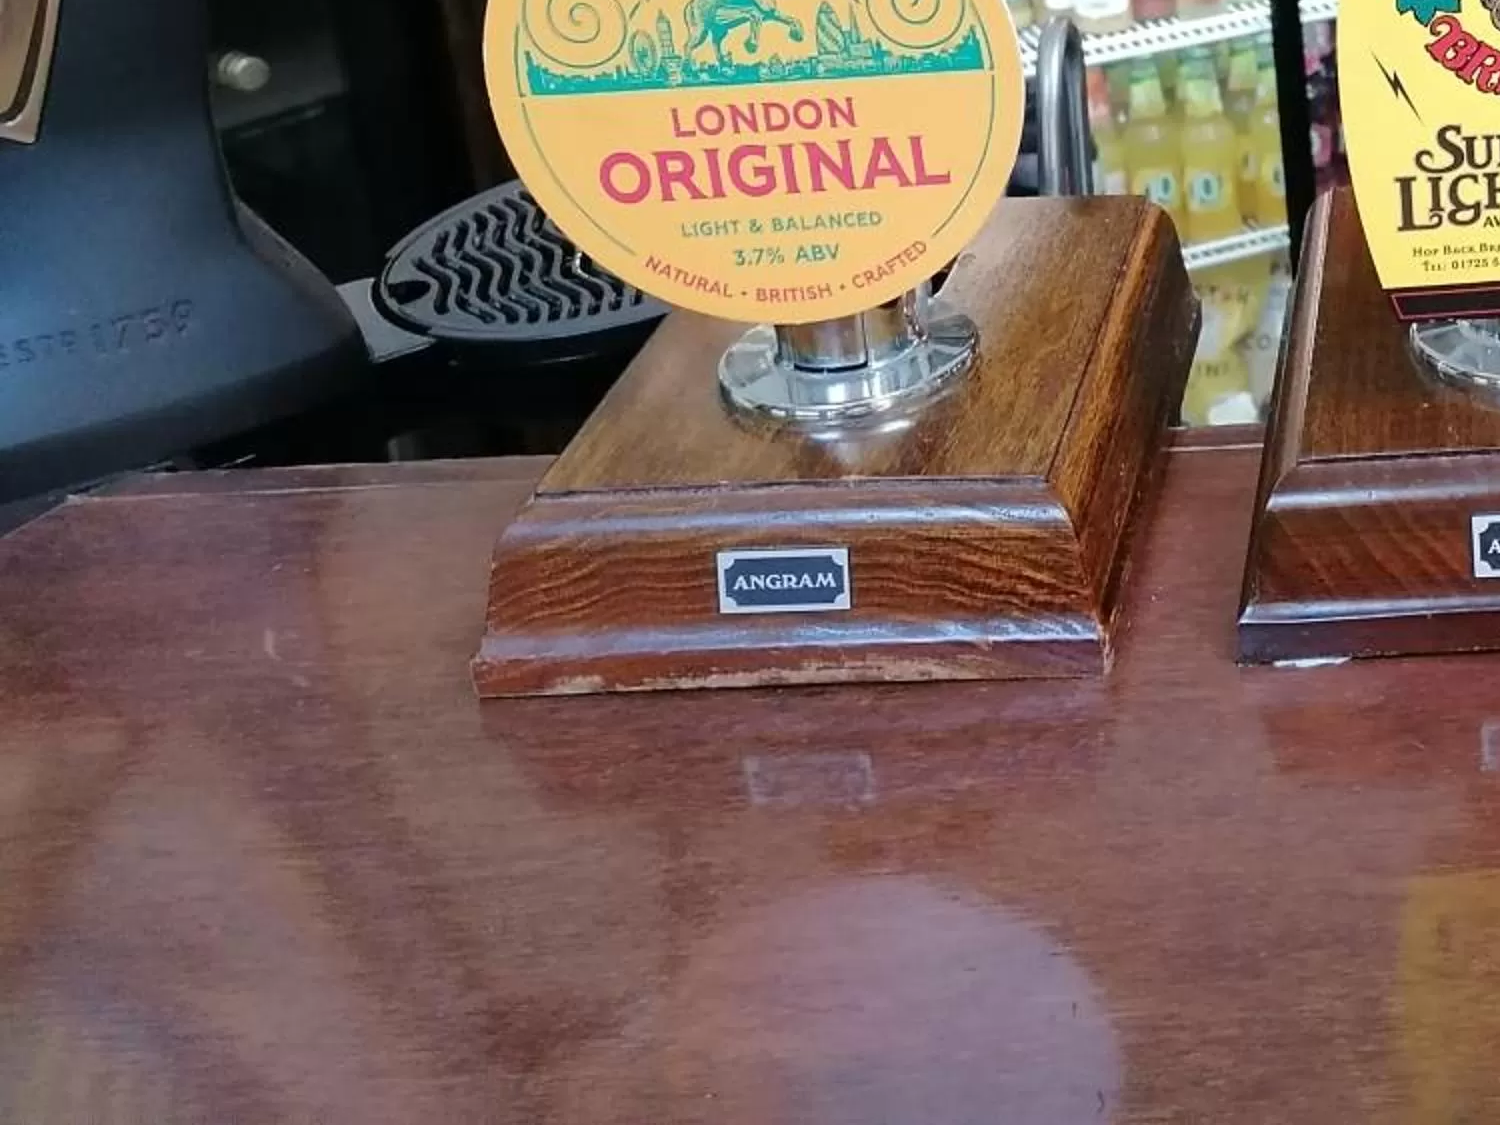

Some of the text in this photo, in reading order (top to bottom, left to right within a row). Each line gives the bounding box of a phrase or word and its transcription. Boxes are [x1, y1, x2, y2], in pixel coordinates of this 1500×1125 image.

[671, 97, 858, 138] LONDON
[600, 136, 951, 204] ORIGINAL
[681, 211, 883, 238] LIGHT & BALANCED
[733, 243, 840, 266] 3.7% ABV
[1451, 257, 1489, 271] 01725
[645, 239, 928, 303] NATURAL BRITISH CRAFTED
[733, 572, 837, 591] ANGRAM
